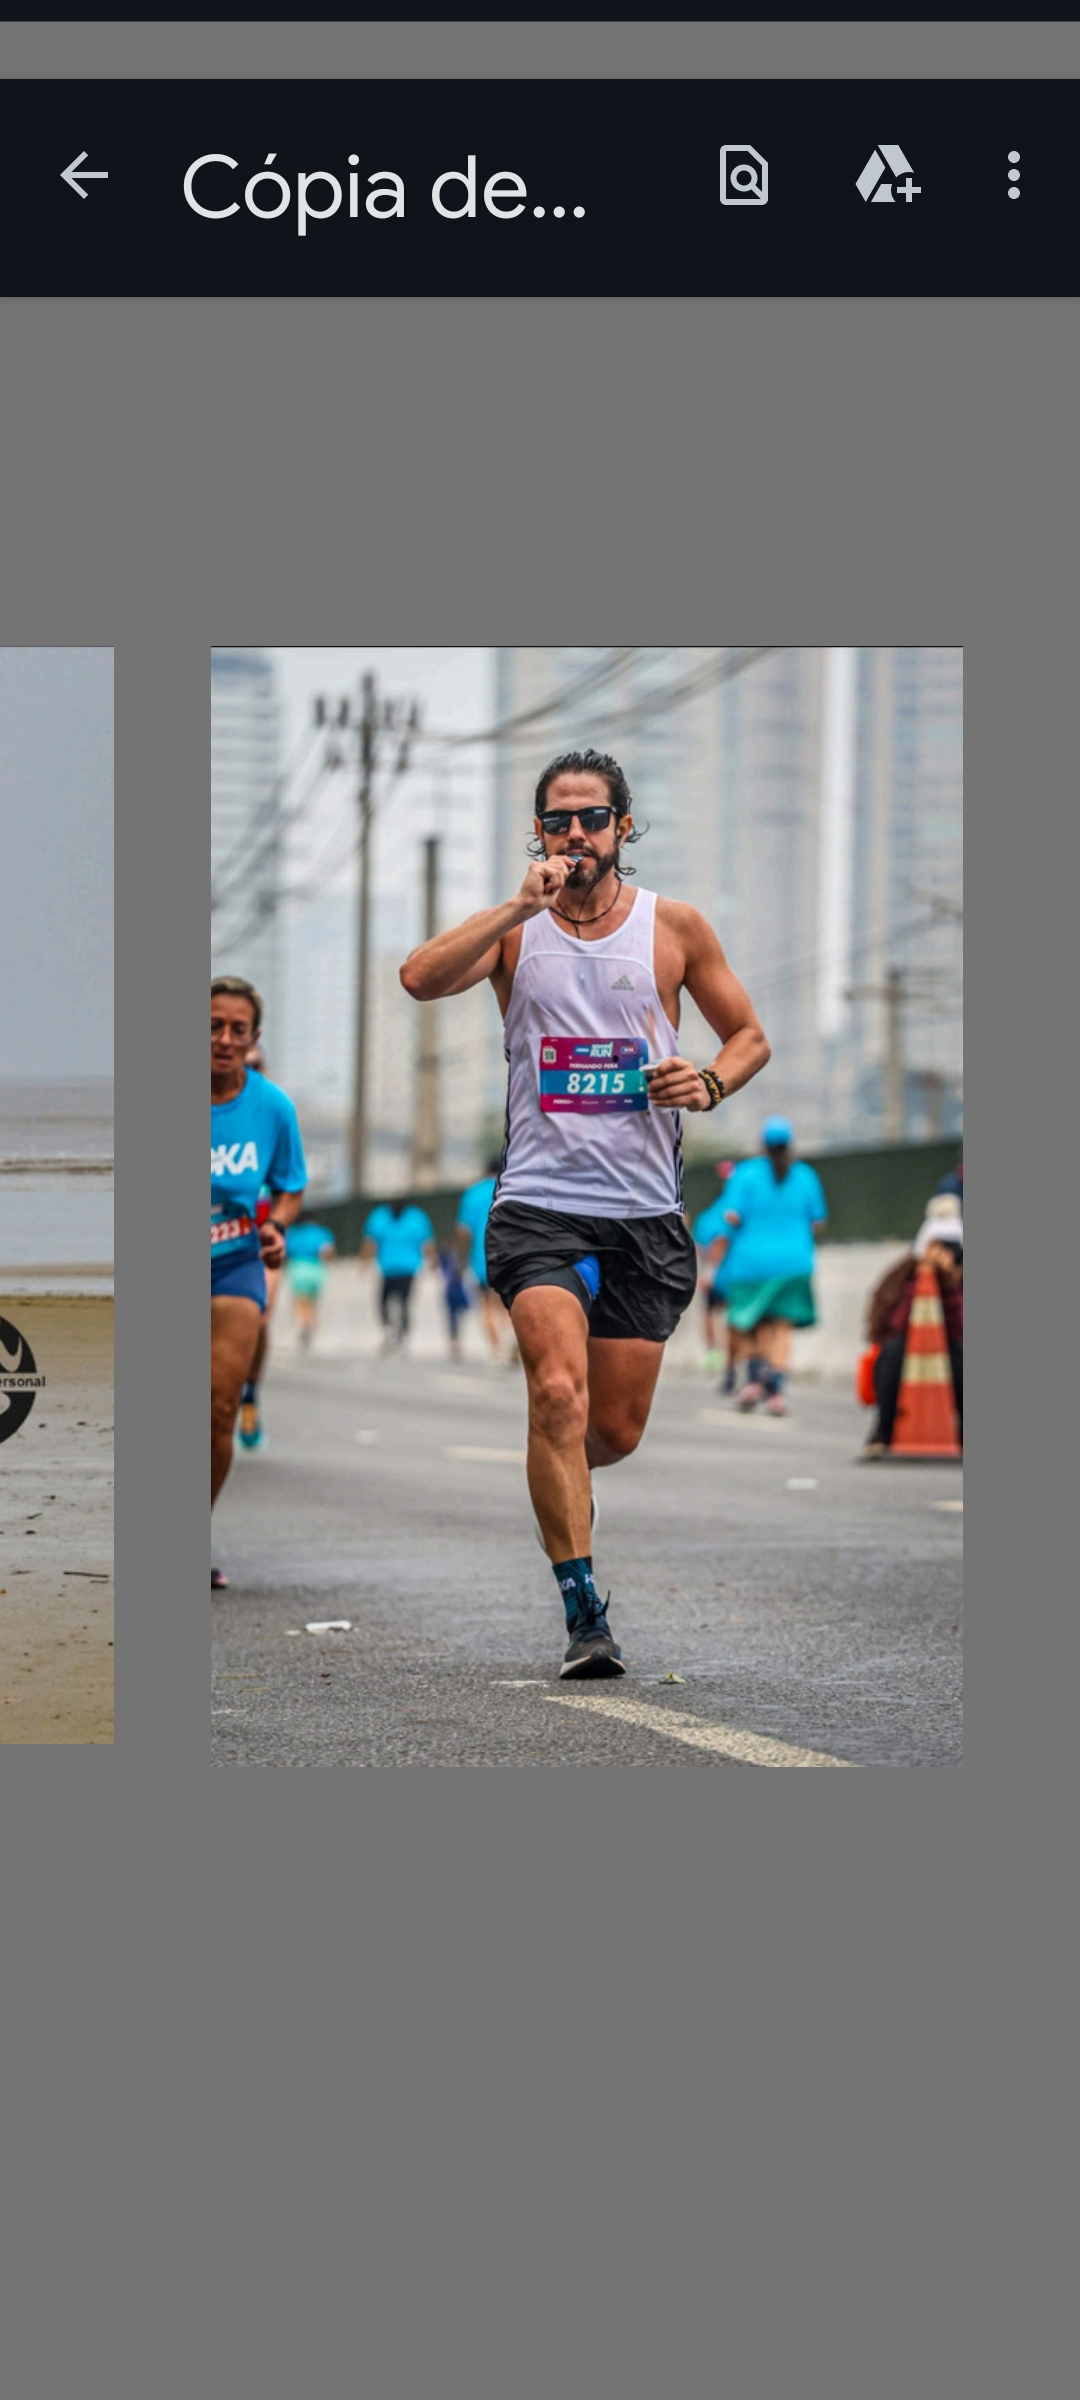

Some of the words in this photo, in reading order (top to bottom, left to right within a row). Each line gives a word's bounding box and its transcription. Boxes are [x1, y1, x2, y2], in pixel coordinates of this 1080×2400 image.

[183, 152, 405, 237] Cópia
[431, 154, 586, 220] de...
[567, 1073, 625, 1094] 8215
